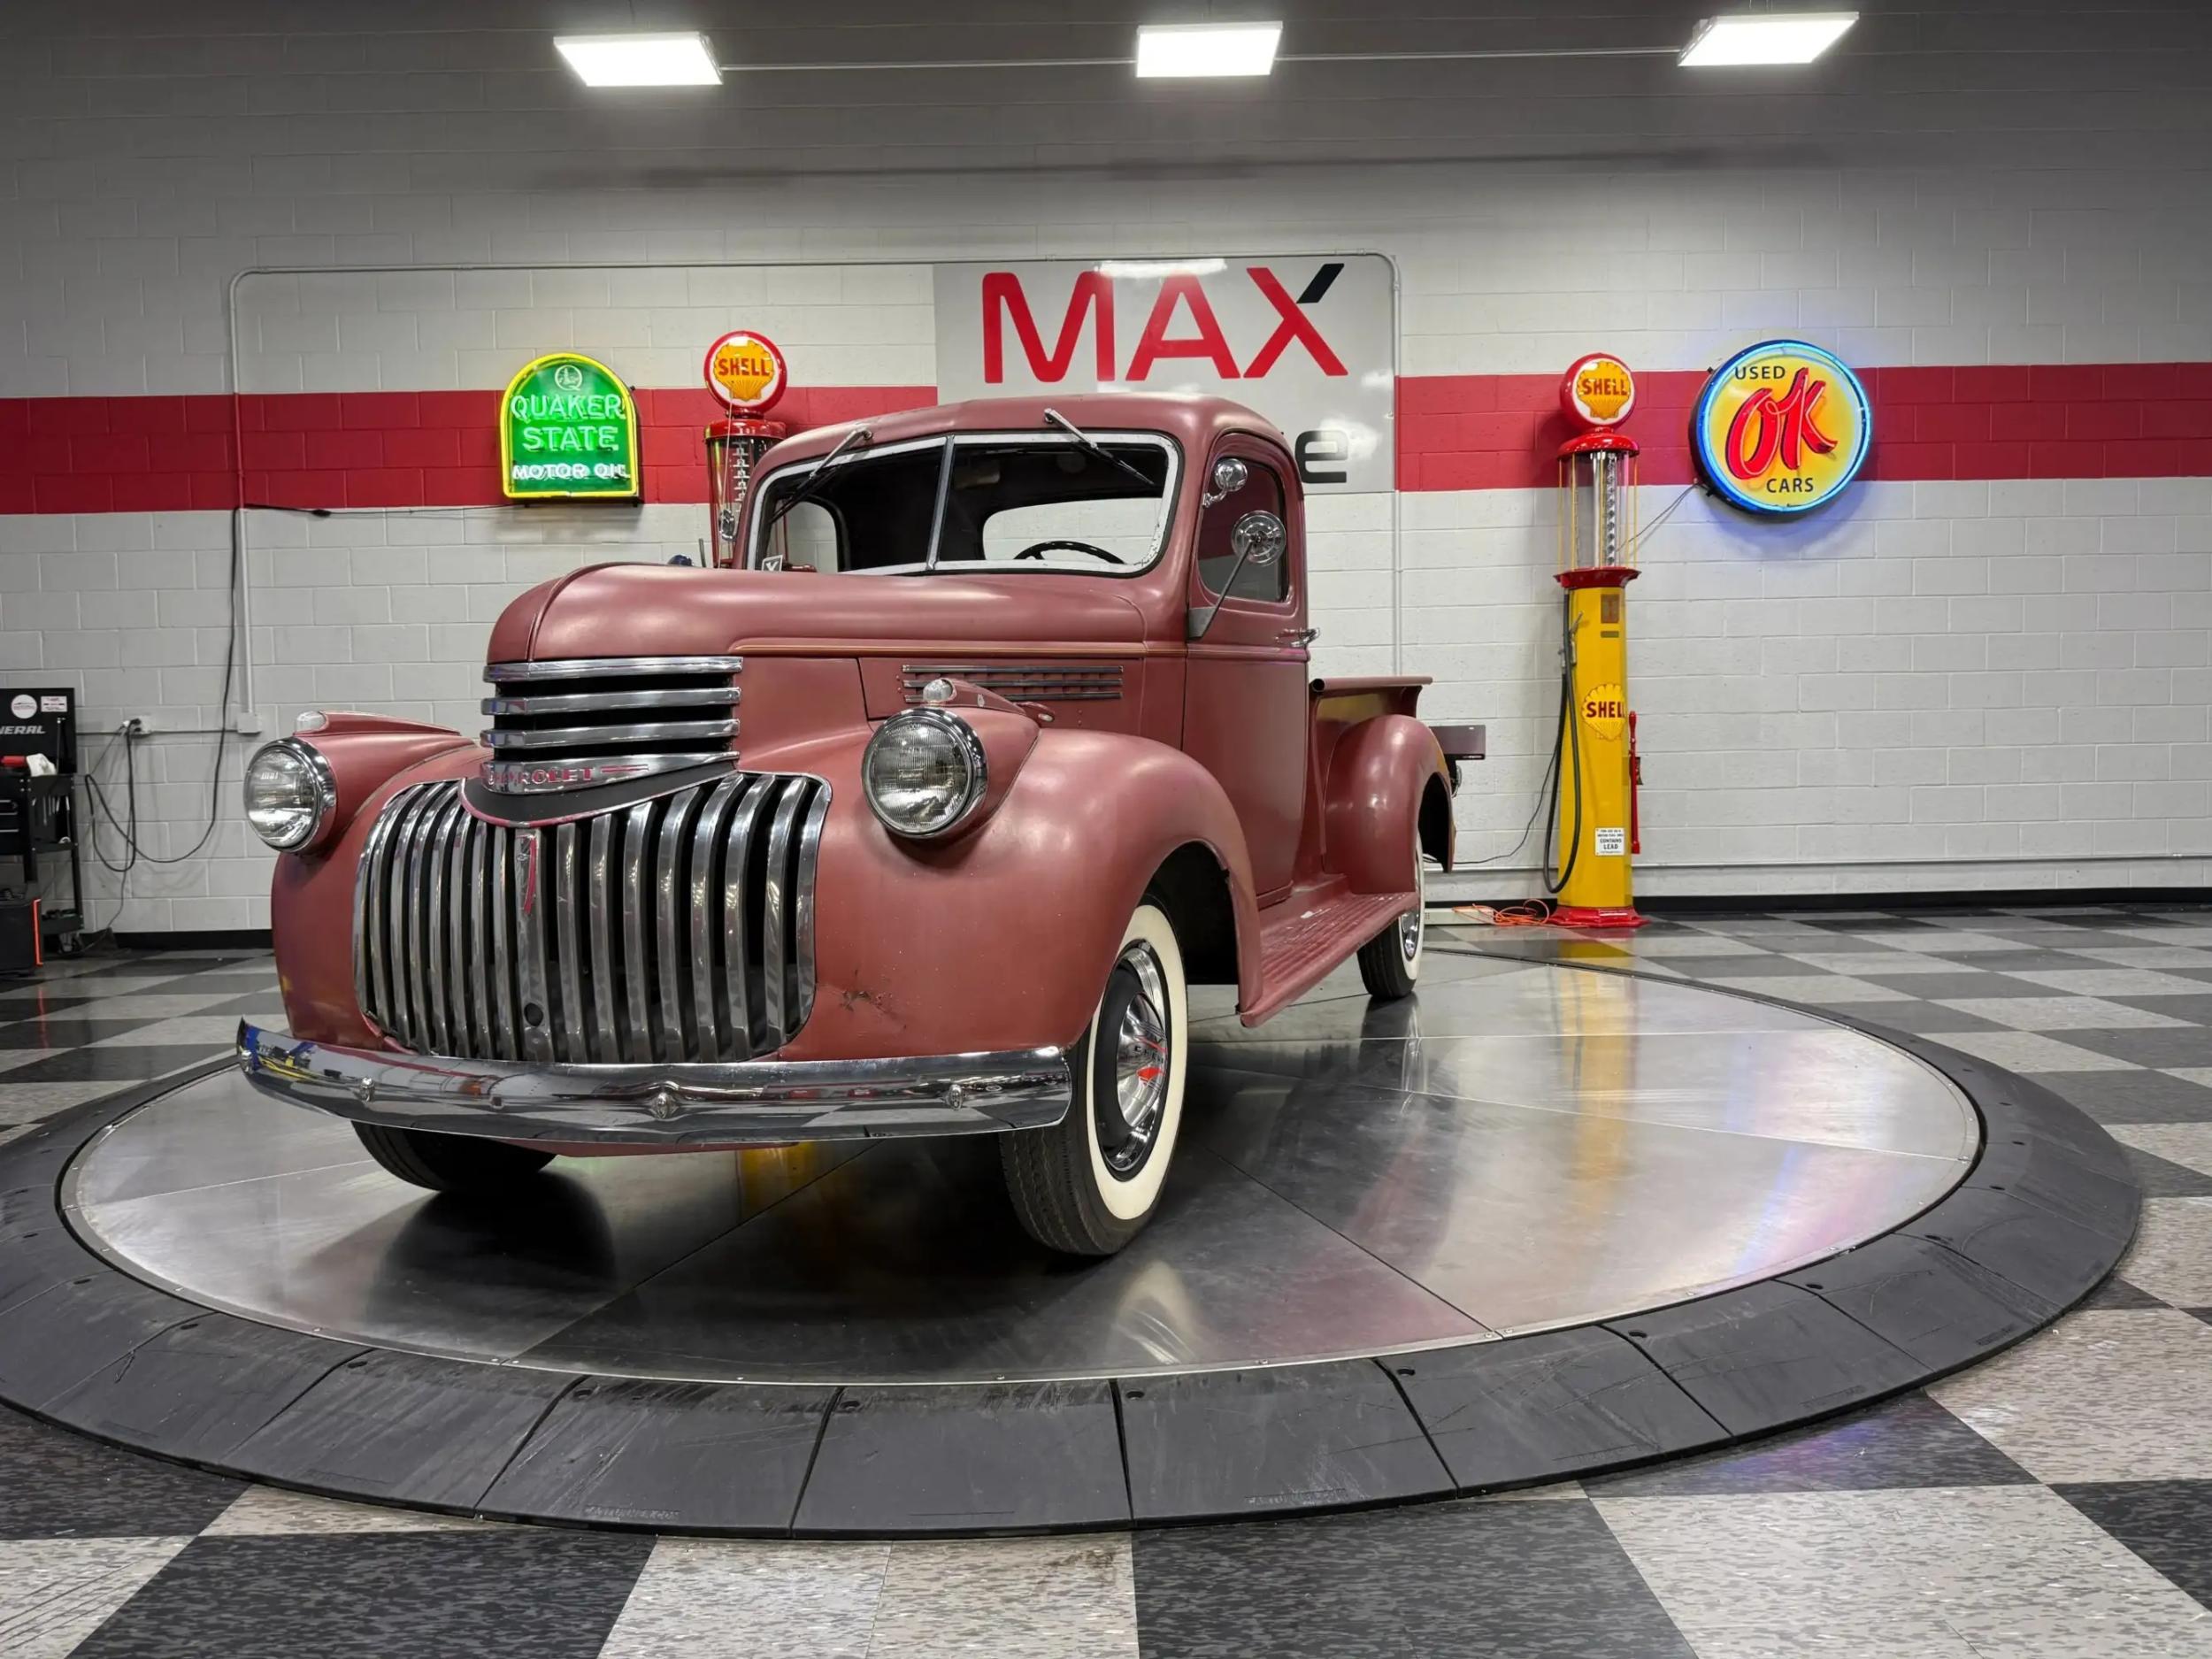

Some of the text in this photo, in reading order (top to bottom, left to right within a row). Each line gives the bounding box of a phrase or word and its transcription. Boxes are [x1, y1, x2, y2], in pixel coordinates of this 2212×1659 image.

[982, 263, 1348, 384] MAX
[718, 357, 770, 376] SHELL
[1734, 365, 1786, 380] USED
[1581, 378, 1627, 396] SHELL
[511, 394, 626, 423] QUAKER
[1725, 367, 1839, 480] OK
[522, 426, 619, 451] STATE
[512, 463, 631, 480] MOTOR OIL
[1766, 478, 1814, 493] CARS
